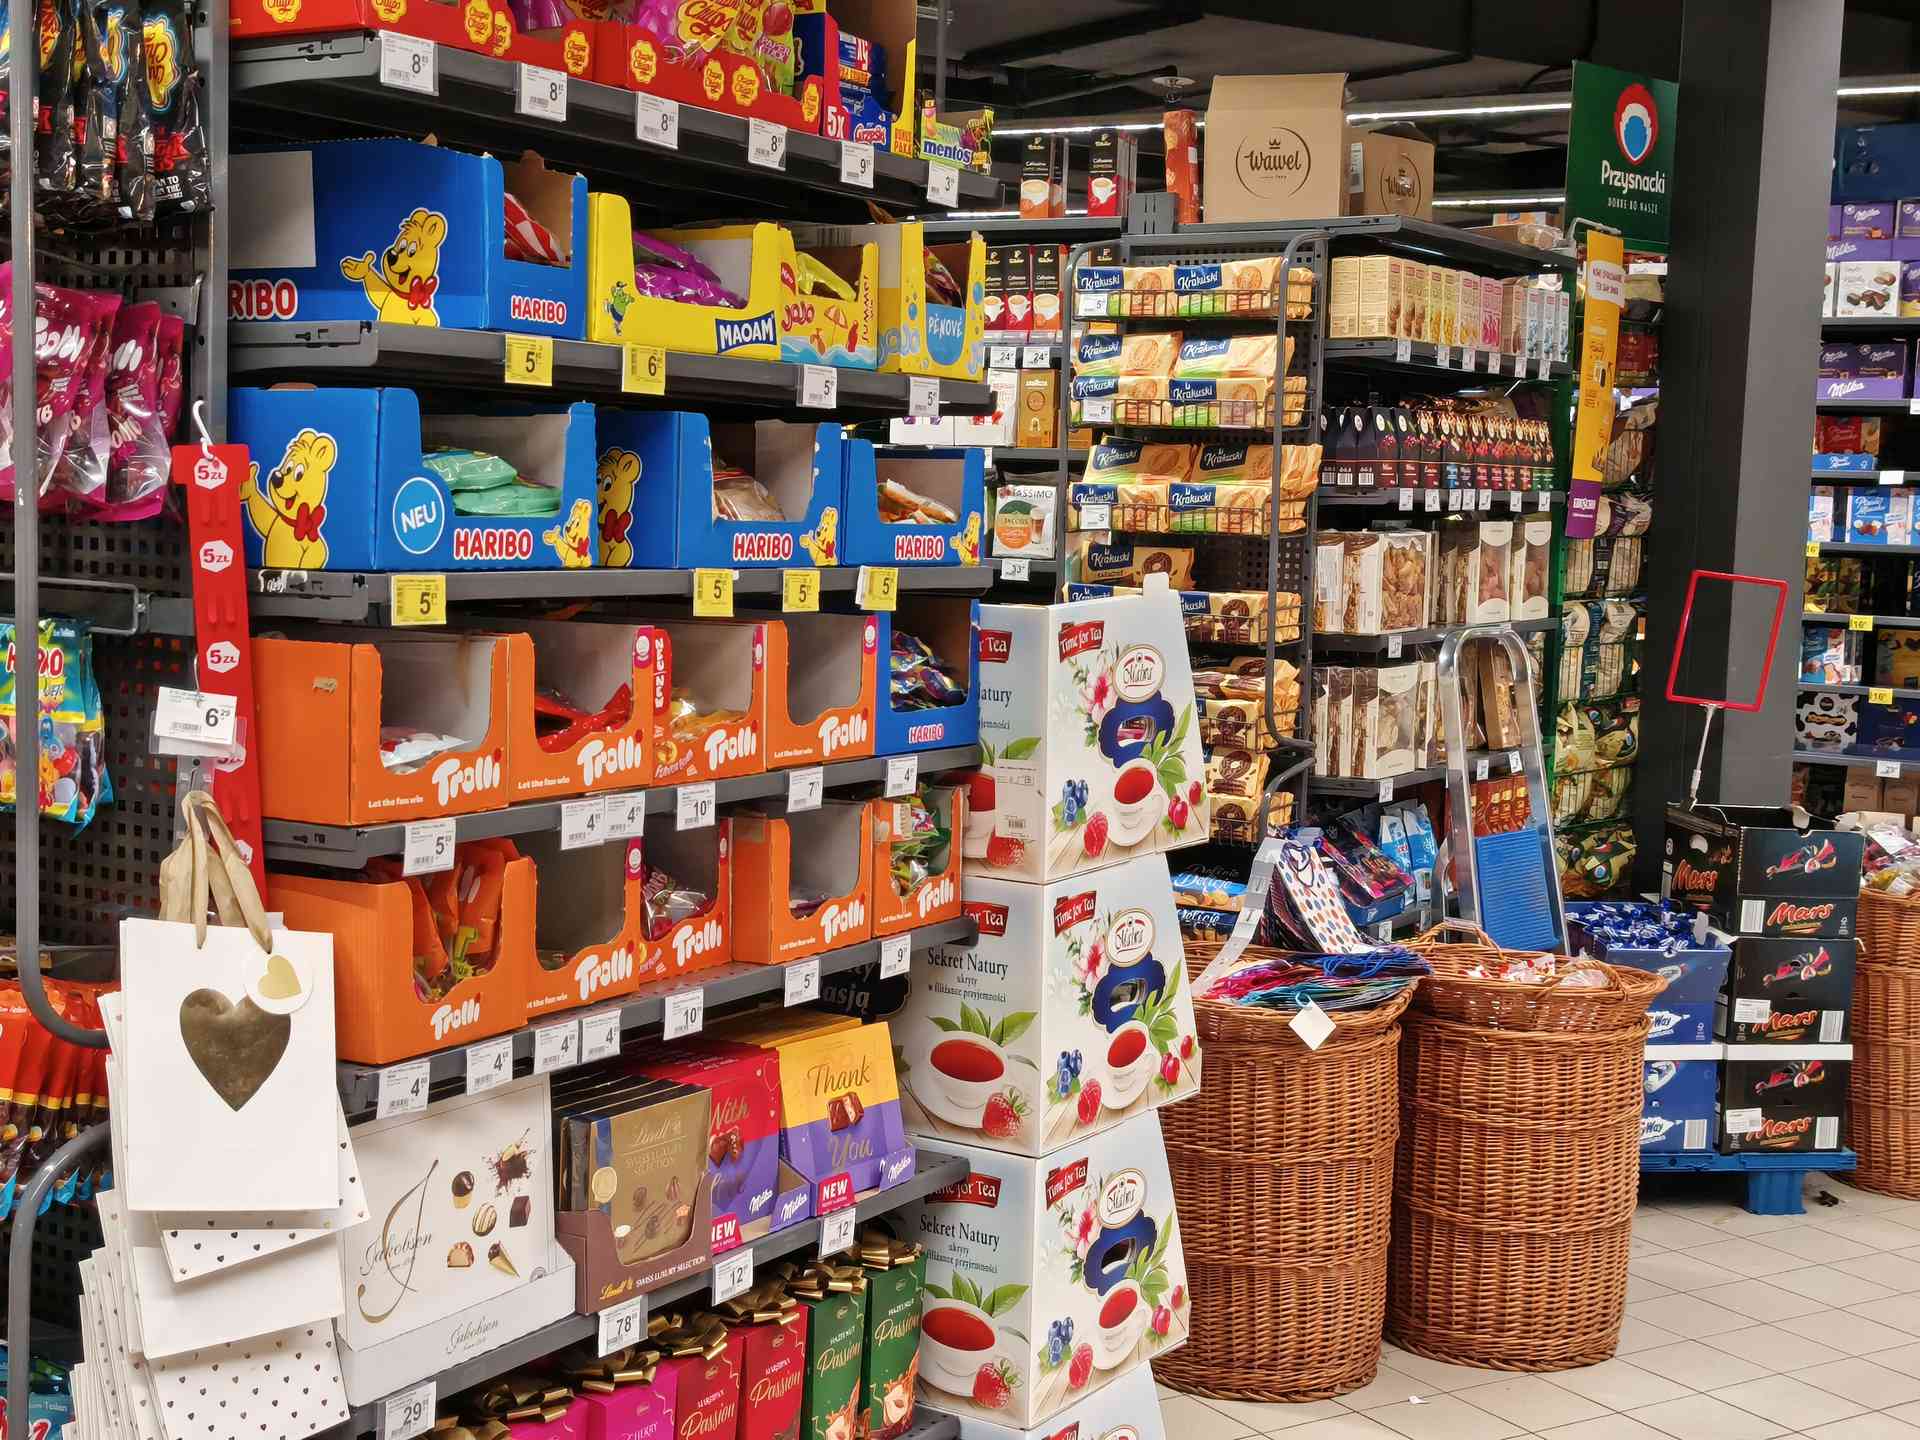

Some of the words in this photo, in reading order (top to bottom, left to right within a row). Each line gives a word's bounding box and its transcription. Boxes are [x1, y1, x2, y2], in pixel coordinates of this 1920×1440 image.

[411, 53, 421, 74] 8
[550, 82, 558, 101] 8
[660, 113, 668, 132] 8
[771, 138, 778, 152] 8
[923, 140, 971, 164] mentos
[860, 159, 866, 175] 9
[1601, 159, 1665, 194] Przysnacki
[945, 175, 951, 192] 3
[1825, 243, 1857, 259] Milka
[1080, 273, 1120, 290] Krakuski
[229, 280, 297, 319] RIBO
[511, 295, 567, 325] HARIBO
[719, 317, 775, 350] MAOAM
[1081, 341, 1119, 358] Krakuski
[525, 351, 536, 373] 5
[648, 355, 657, 377] 6
[823, 379, 830, 396] 5
[1827, 381, 1865, 397] Milka
[927, 391, 934, 406] 5
[1096, 449, 1137, 466] Krakuski
[1204, 449, 1243, 466] Krakuski
[1172, 490, 1212, 506] Krakuski
[400, 501, 437, 533] NEU
[454, 528, 533, 560] HARIBO
[733, 533, 793, 561] HARIBO
[895, 535, 944, 560] HARIBO
[1091, 550, 1130, 566] Krakuski
[713, 580, 722, 599] 5
[799, 585, 807, 603] 5
[882, 577, 890, 595] 5
[419, 594, 431, 615] 5
[985, 637, 1007, 652] Tea
[1060, 635, 1078, 653] Time
[1078, 631, 1089, 648] for
[1090, 627, 1102, 641] Tea
[981, 687, 1012, 708] atury
[205, 708, 218, 727] 6
[818, 708, 868, 757] Trolli
[908, 723, 945, 744] HARIBO
[703, 719, 758, 771] Trolli
[577, 729, 643, 786] Trolli
[432, 747, 502, 806] Trolli
[904, 768, 910, 781] 4
[809, 782, 814, 796] 7
[627, 807, 636, 824] 4
[693, 801, 706, 816] 10
[587, 813, 595, 831] 4
[435, 835, 445, 855] 5
[1672, 858, 1719, 893] Mars
[917, 871, 954, 919] Trolli
[820, 894, 865, 944] Trolli
[983, 910, 1004, 926] Tea
[1055, 910, 1074, 927] Time
[1073, 904, 1085, 920] for
[1085, 898, 1096, 912] Tea
[1767, 901, 1836, 927] Mars
[672, 912, 723, 967] Trolli
[896, 948, 903, 963] 9
[928, 946, 963, 969] Sekret
[967, 953, 1008, 980] Natury
[574, 941, 634, 1000] Trolli
[804, 975, 811, 989] 5
[431, 992, 482, 1040] Trolli
[683, 1007, 697, 1025] 10
[1653, 1014, 1671, 1027] Way
[1751, 1009, 1818, 1034] Mars
[561, 1036, 569, 1052] 4
[605, 1028, 614, 1044] 4
[494, 1053, 503, 1072] 4
[808, 1055, 872, 1097] Thank
[410, 1077, 420, 1097] 4
[632, 1120, 669, 1147] Lindt
[1646, 1121, 1663, 1134] Way
[1745, 1117, 1813, 1142] Mars
[827, 1133, 874, 1169] You
[889, 1158, 912, 1182] Milka
[823, 1179, 848, 1199] NEW
[975, 1181, 996, 1197] Tea
[1047, 1181, 1064, 1200] Time
[1063, 1175, 1074, 1190] for
[1074, 1165, 1087, 1182] Tea
[749, 1189, 773, 1214] Milka
[781, 1193, 807, 1221] Milka
[837, 1221, 849, 1237] 12
[919, 1214, 955, 1238] Sekret
[959, 1222, 1000, 1252] Natury
[636, 1275, 655, 1288] SWISS
[677, 1256, 706, 1272] SELECTION
[731, 1267, 744, 1286] 12
[600, 1279, 626, 1300] Lindt
[616, 1314, 632, 1337] 78
[874, 1311, 921, 1346] Passion
[816, 1341, 861, 1377] Passion
[750, 1370, 800, 1409] Passion
[403, 1400, 422, 1426] 29
[680, 1402, 736, 1440] Passion
